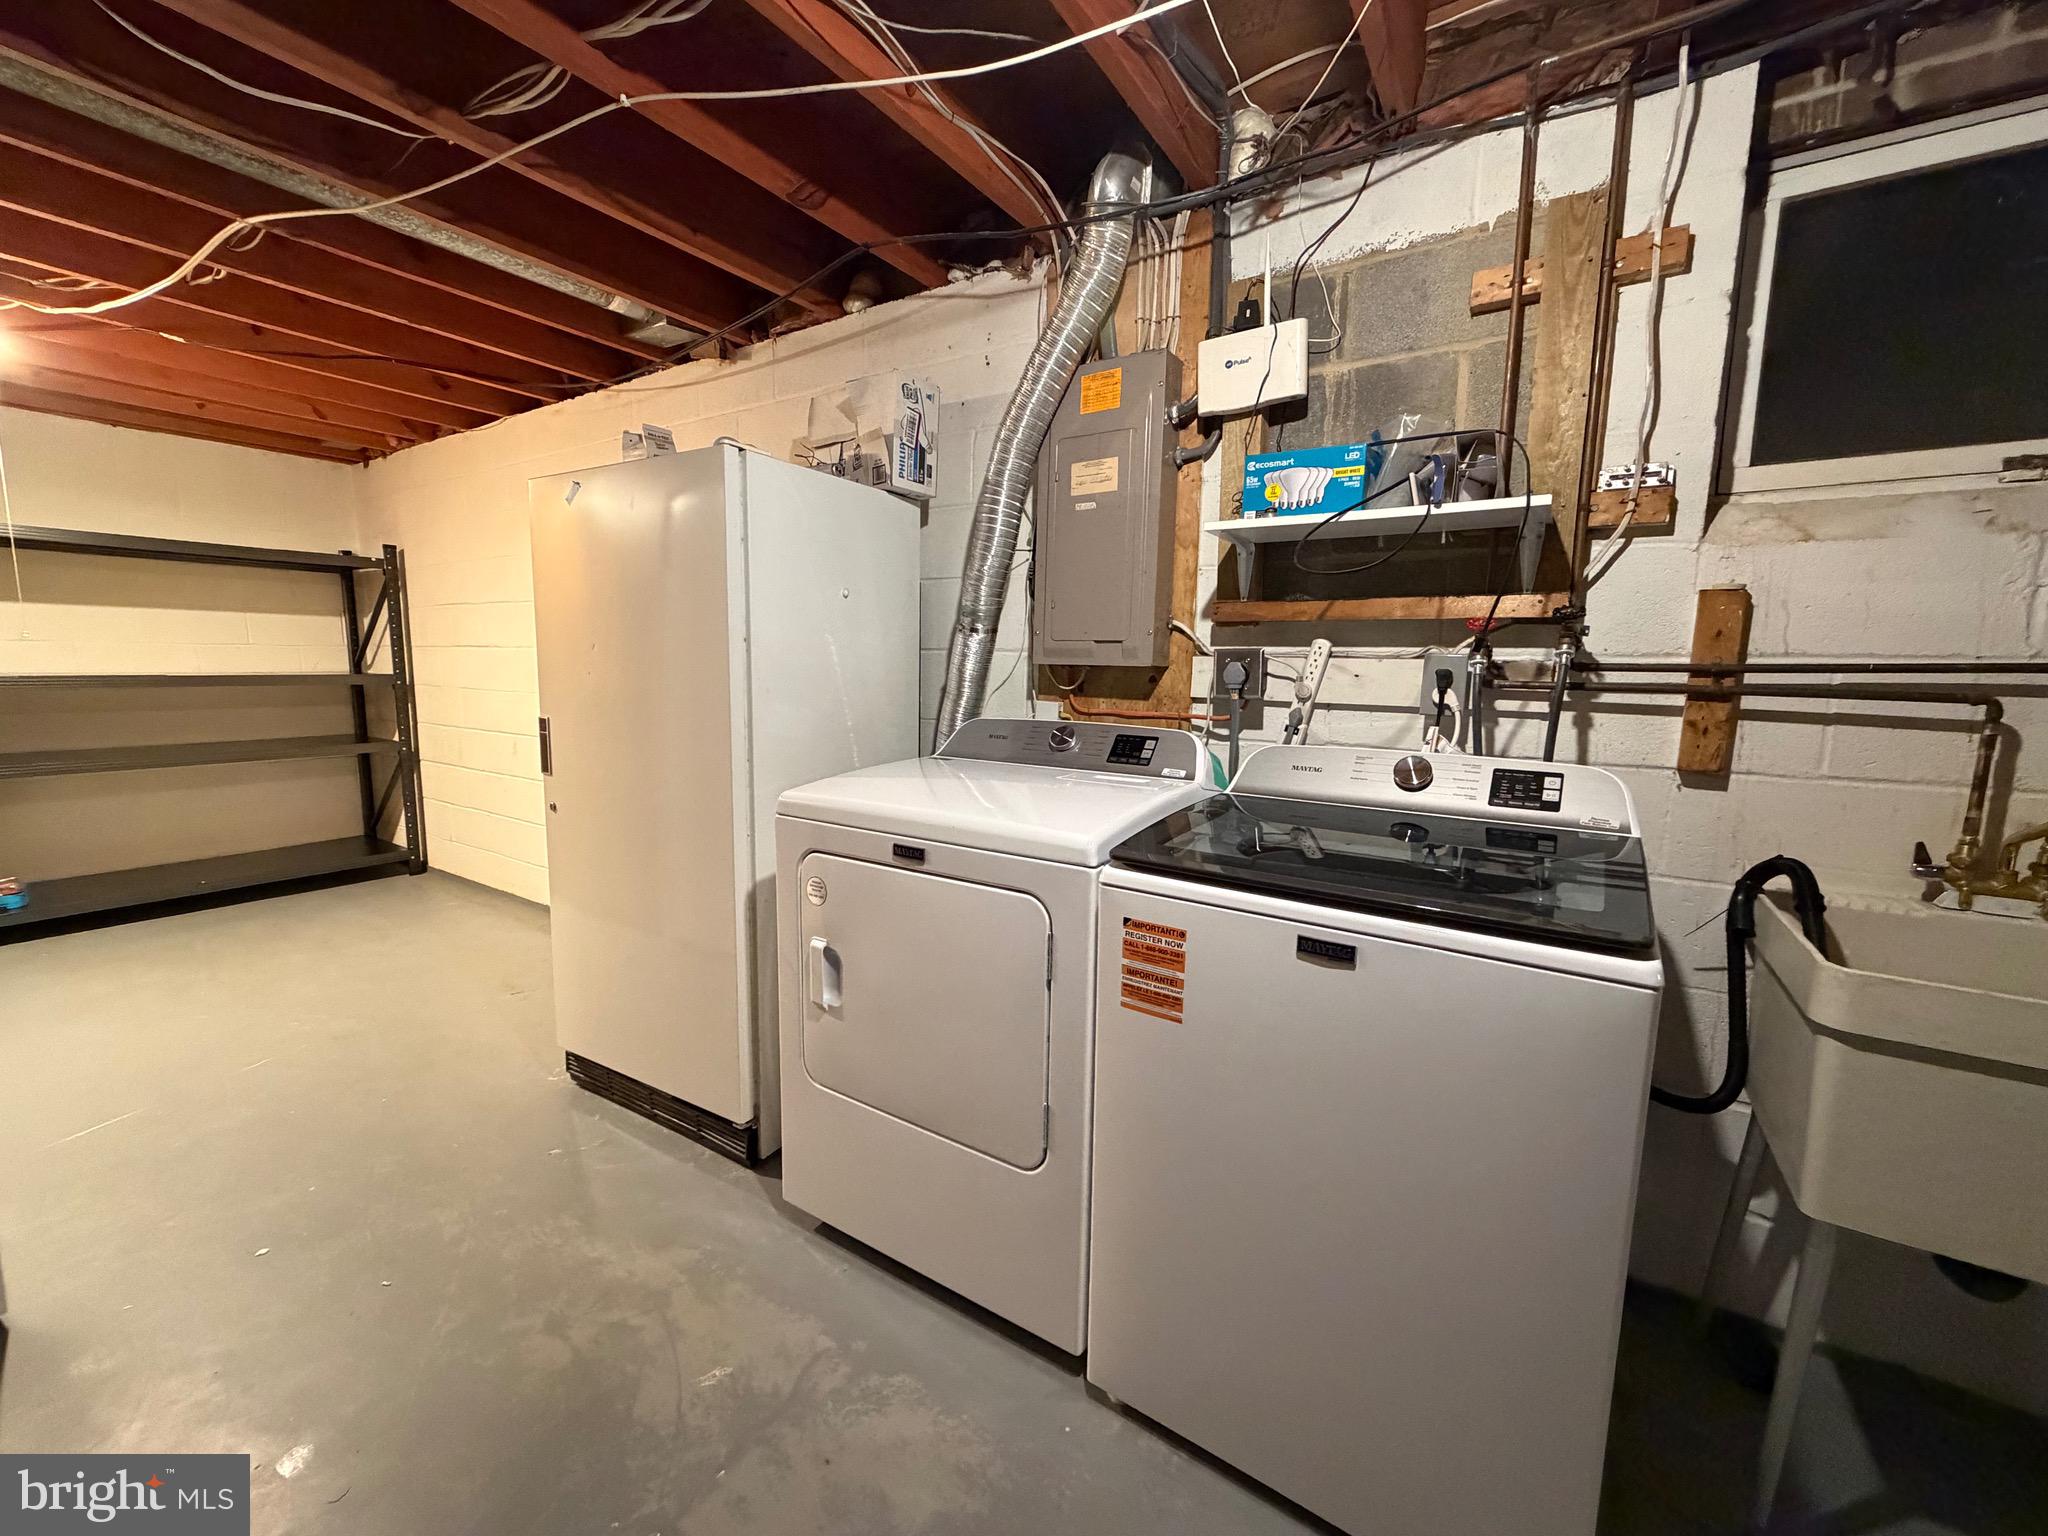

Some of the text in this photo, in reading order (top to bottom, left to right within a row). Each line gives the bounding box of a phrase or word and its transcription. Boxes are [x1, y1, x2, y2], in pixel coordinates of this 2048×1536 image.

[898, 436, 906, 480] PHILIP
[1344, 451, 1360, 460] LED
[1255, 458, 1294, 469] ecosmart
[1291, 764, 1323, 773] MAYTAG
[894, 846, 923, 859] MAYTAG
[1123, 940, 1140, 950] CALL
[1124, 930, 1184, 950] REGISTER NOW
[1300, 940, 1353, 960] MAYTAG
